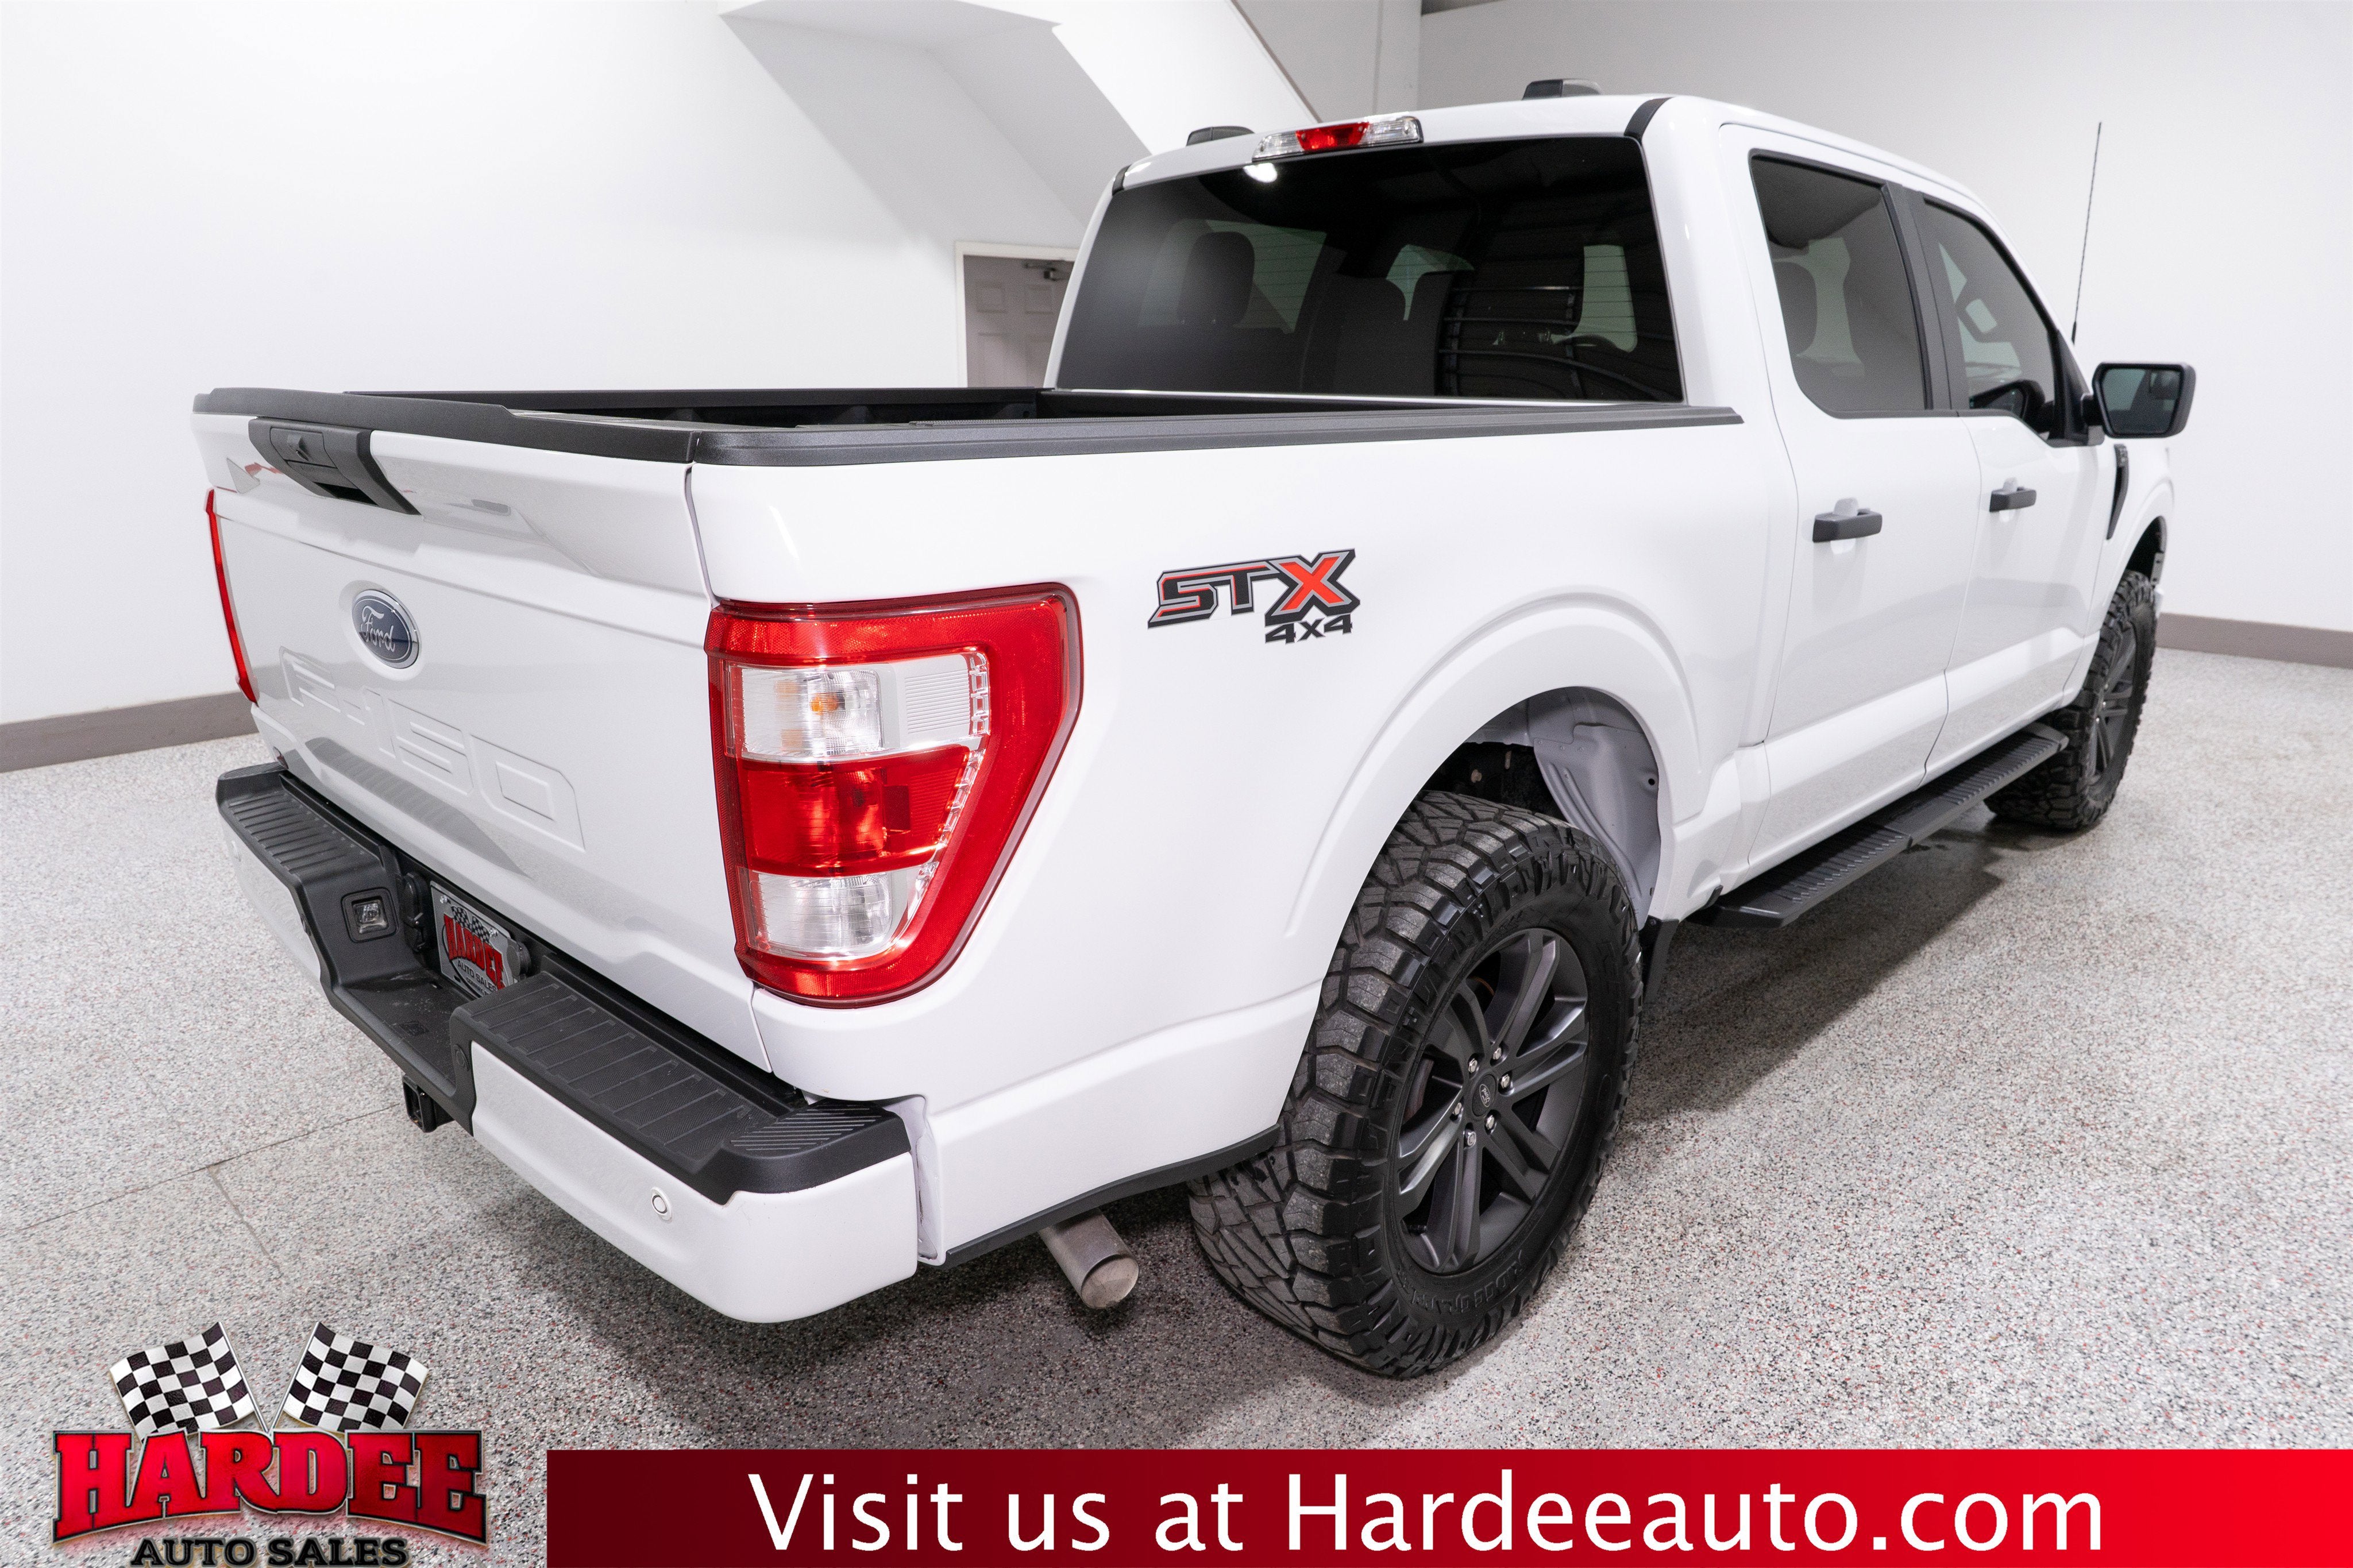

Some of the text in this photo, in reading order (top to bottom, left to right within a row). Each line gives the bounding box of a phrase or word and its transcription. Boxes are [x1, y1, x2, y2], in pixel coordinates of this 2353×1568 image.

[1148, 548, 1360, 629] STX
[361, 605, 395, 652] Ford
[443, 913, 506, 990] HARDEE
[458, 959, 475, 978] AUTO
